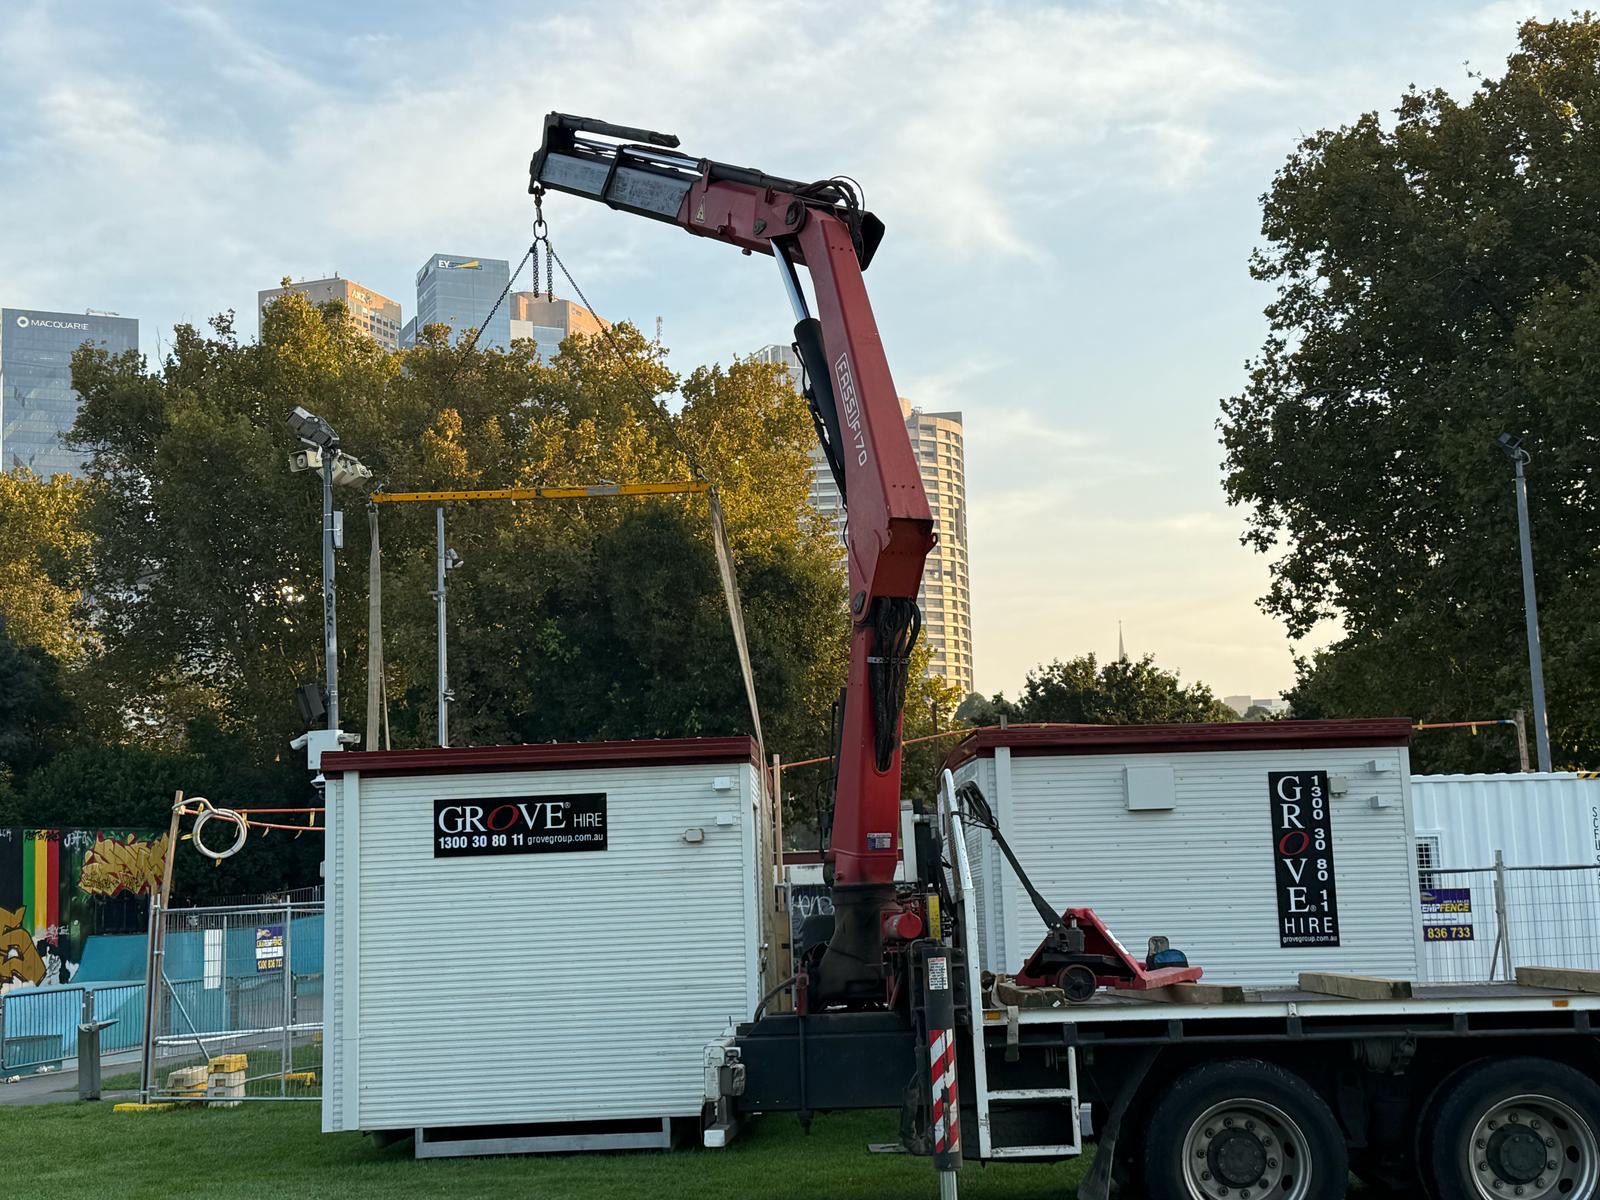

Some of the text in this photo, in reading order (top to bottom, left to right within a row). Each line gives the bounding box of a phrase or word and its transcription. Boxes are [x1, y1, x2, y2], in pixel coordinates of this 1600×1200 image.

[438, 260, 449, 268] EY
[30, 319, 89, 331] MACQUARIE
[838, 361, 868, 466] FASSI F170
[573, 812, 603, 828] HIRE
[438, 832, 604, 849] 1300 30 80 11 grovegroup.com.au
[1311, 774, 1329, 912] 1300 30 80 11
[1421, 903, 1469, 912] EMPFENCE
[1284, 917, 1334, 934] HIRE
[1427, 926, 1471, 939] 836 733
[1282, 935, 1338, 944] grovegroup.com.au
